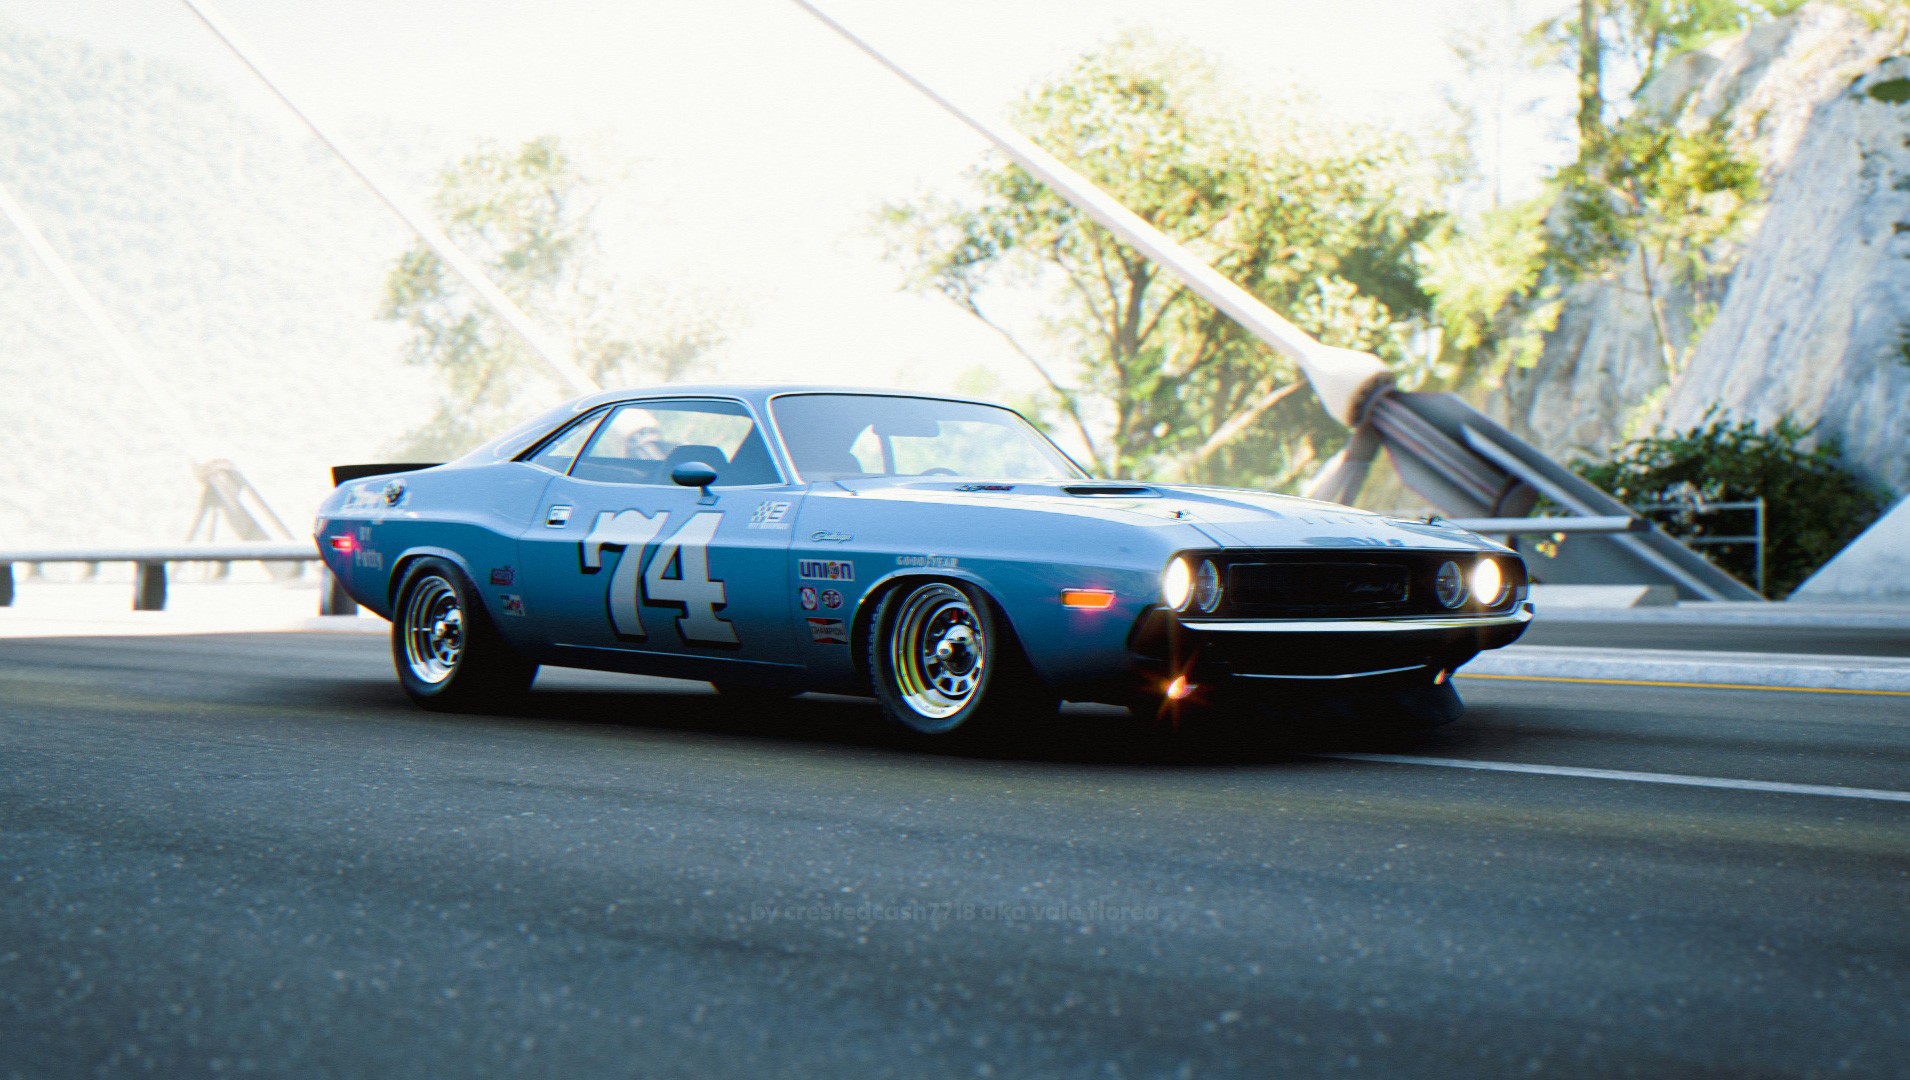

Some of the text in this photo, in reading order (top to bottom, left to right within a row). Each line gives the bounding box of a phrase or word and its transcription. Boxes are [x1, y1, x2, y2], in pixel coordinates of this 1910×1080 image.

[896, 555, 959, 568] GOODYEAR
[579, 509, 740, 646] 74
[822, 590, 840, 608] STP
